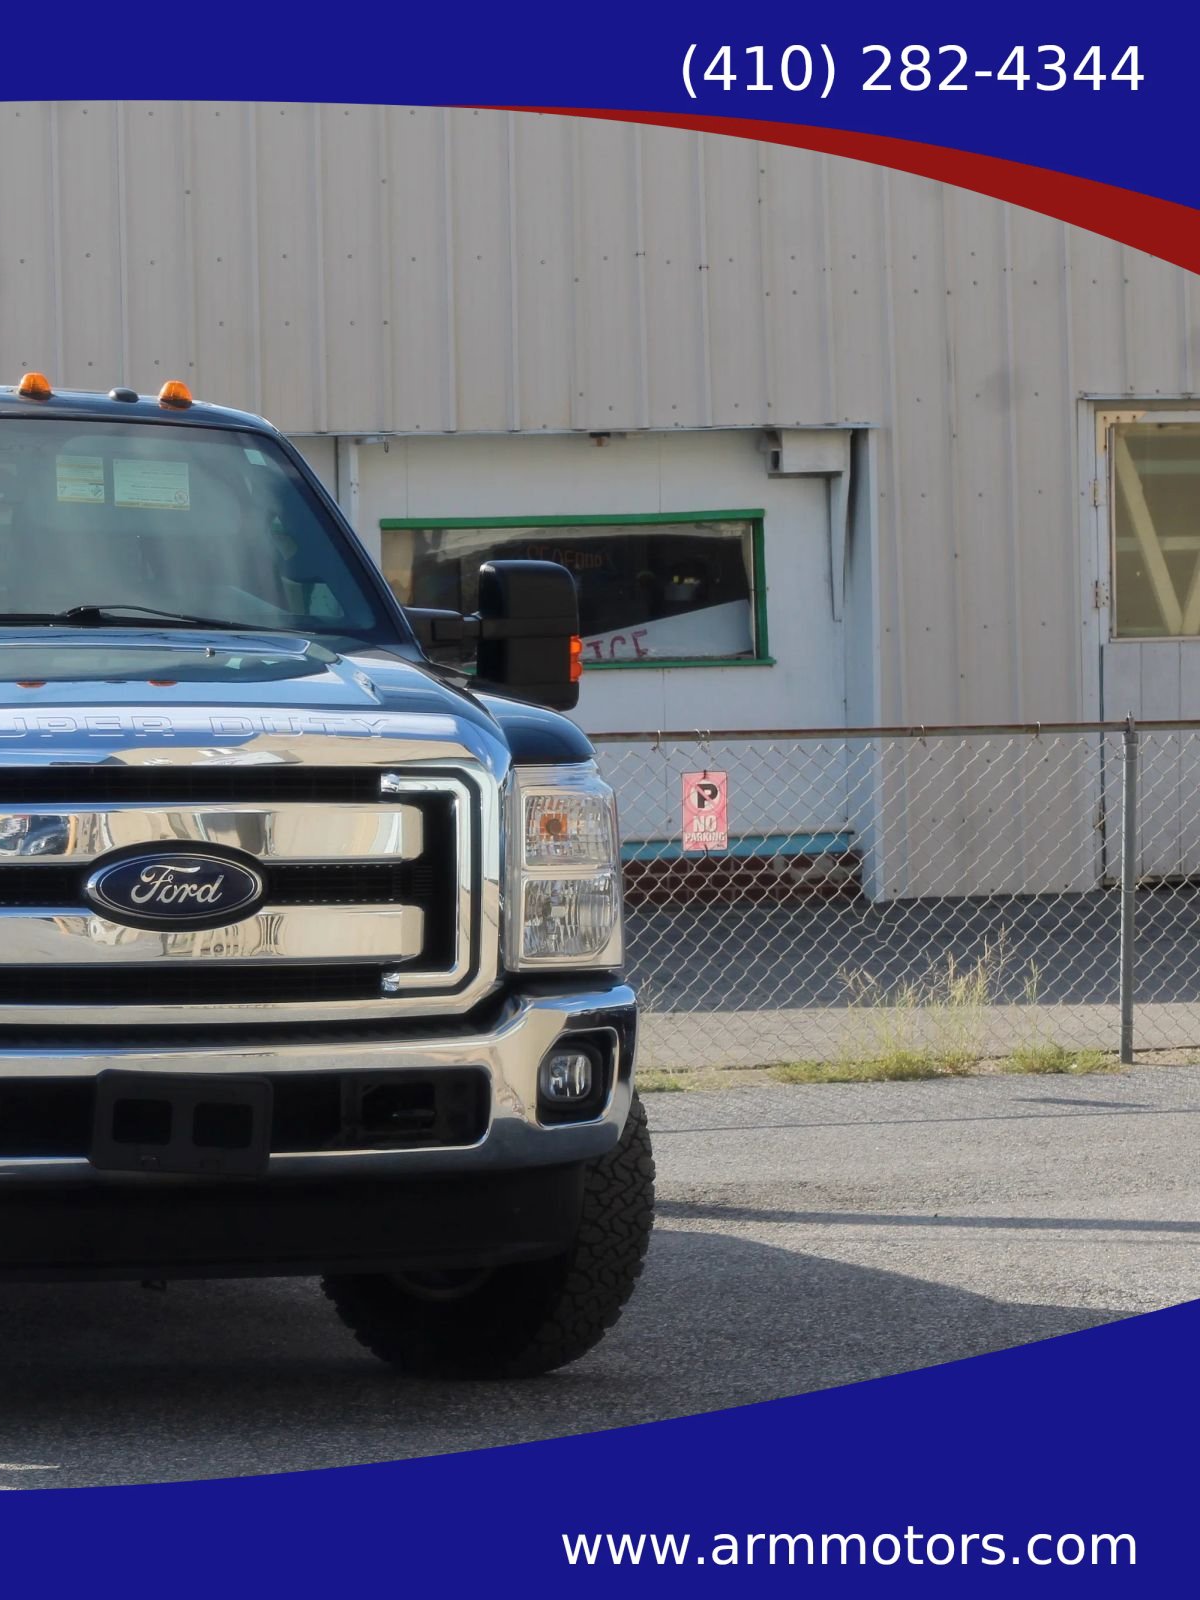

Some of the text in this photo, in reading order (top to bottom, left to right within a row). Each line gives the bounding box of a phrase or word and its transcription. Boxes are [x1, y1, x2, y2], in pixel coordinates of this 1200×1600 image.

[207, 715, 391, 739] DUTY
[693, 815, 717, 833] NO
[685, 831, 726, 842] PARKING
[130, 864, 225, 904] Ford
